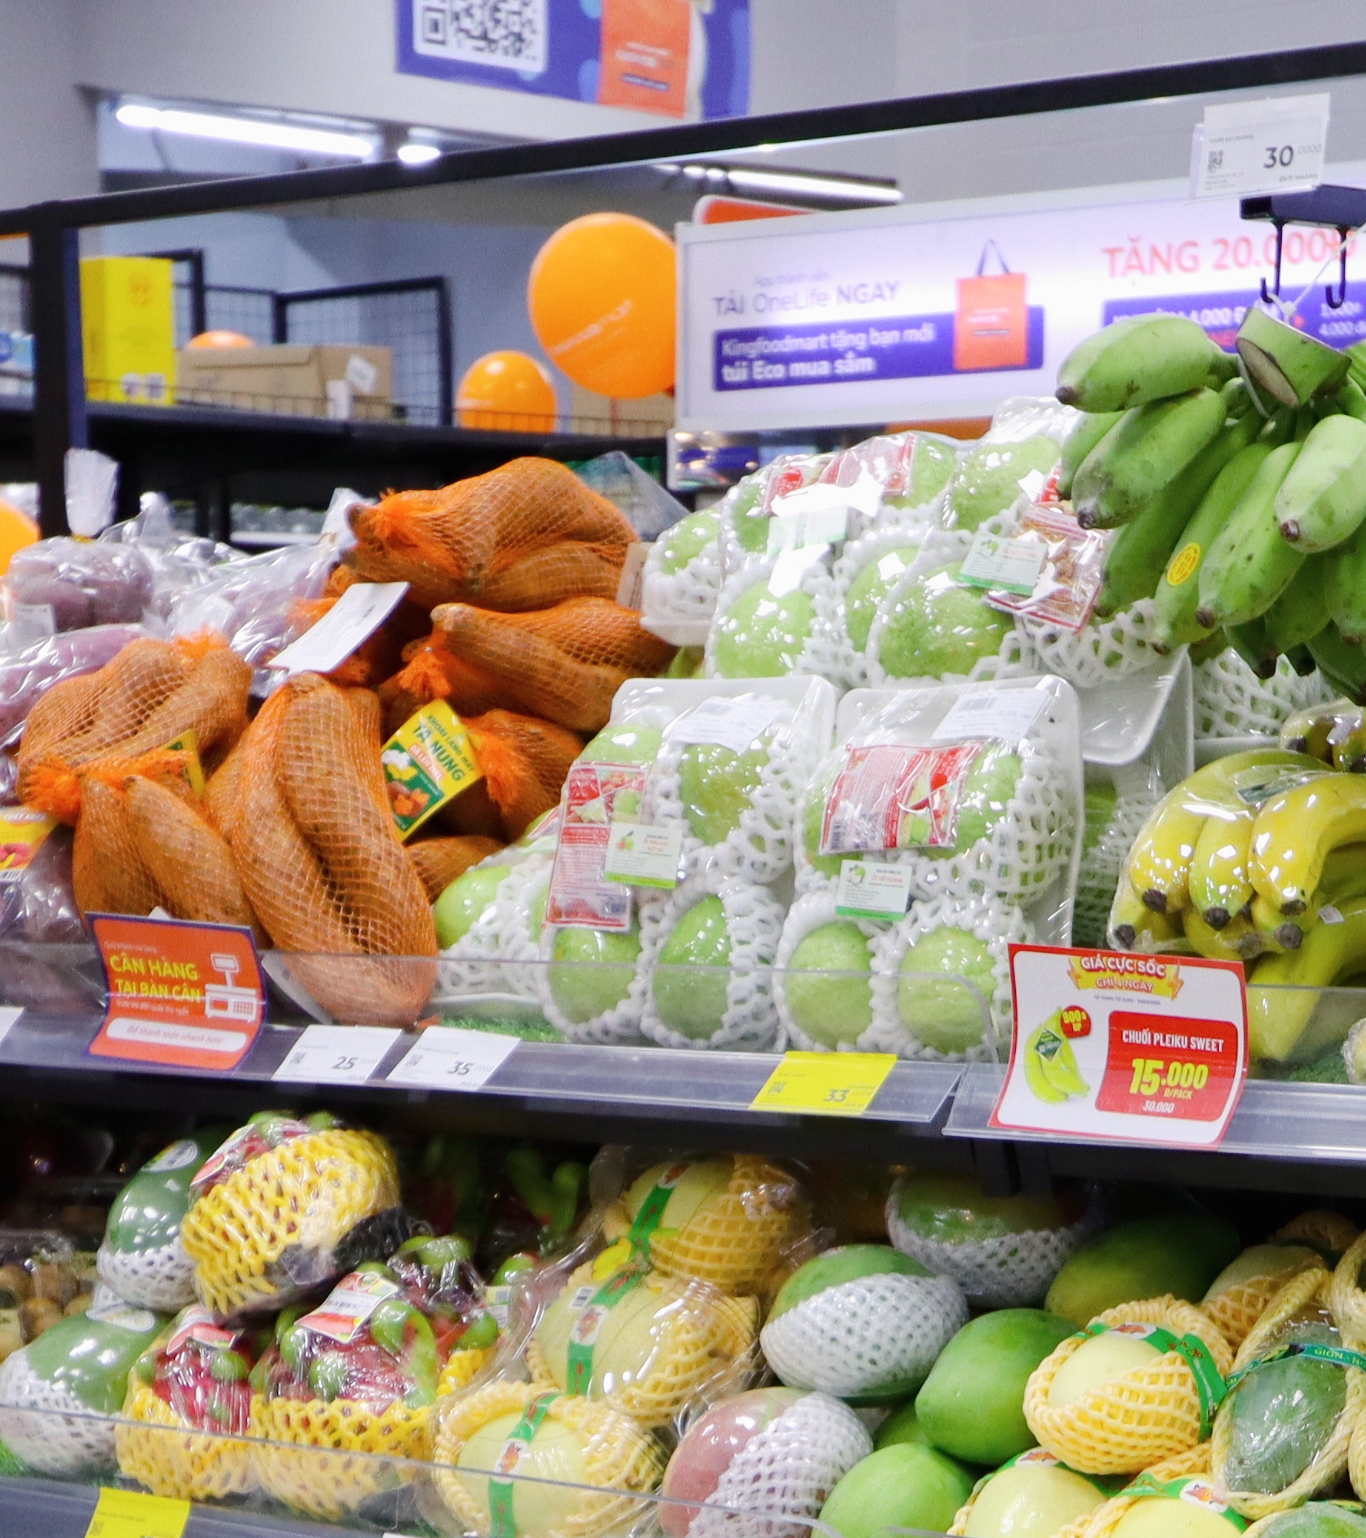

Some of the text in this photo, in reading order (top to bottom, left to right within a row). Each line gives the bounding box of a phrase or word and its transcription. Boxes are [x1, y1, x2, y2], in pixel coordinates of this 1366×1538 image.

[1263, 145, 1294, 168] 30
[836, 280, 901, 306] NGAY
[721, 333, 827, 359] Kingfoodmart
[753, 360, 786, 380] Eco
[789, 361, 830, 379] mua
[110, 952, 200, 981] CÂN HÀNG
[1080, 954, 1167, 977] GIÁ CỰC SỐC
[172, 983, 202, 1004] CÂN
[1122, 1028, 1225, 1053] CHUỐI PLEIKU SWEET
[332, 1056, 359, 1070] 25
[447, 1061, 474, 1076] 35
[1129, 1057, 1209, 1097] 15.000
[822, 1088, 850, 1103] 33
[1142, 1100, 1175, 1114] 30.000
